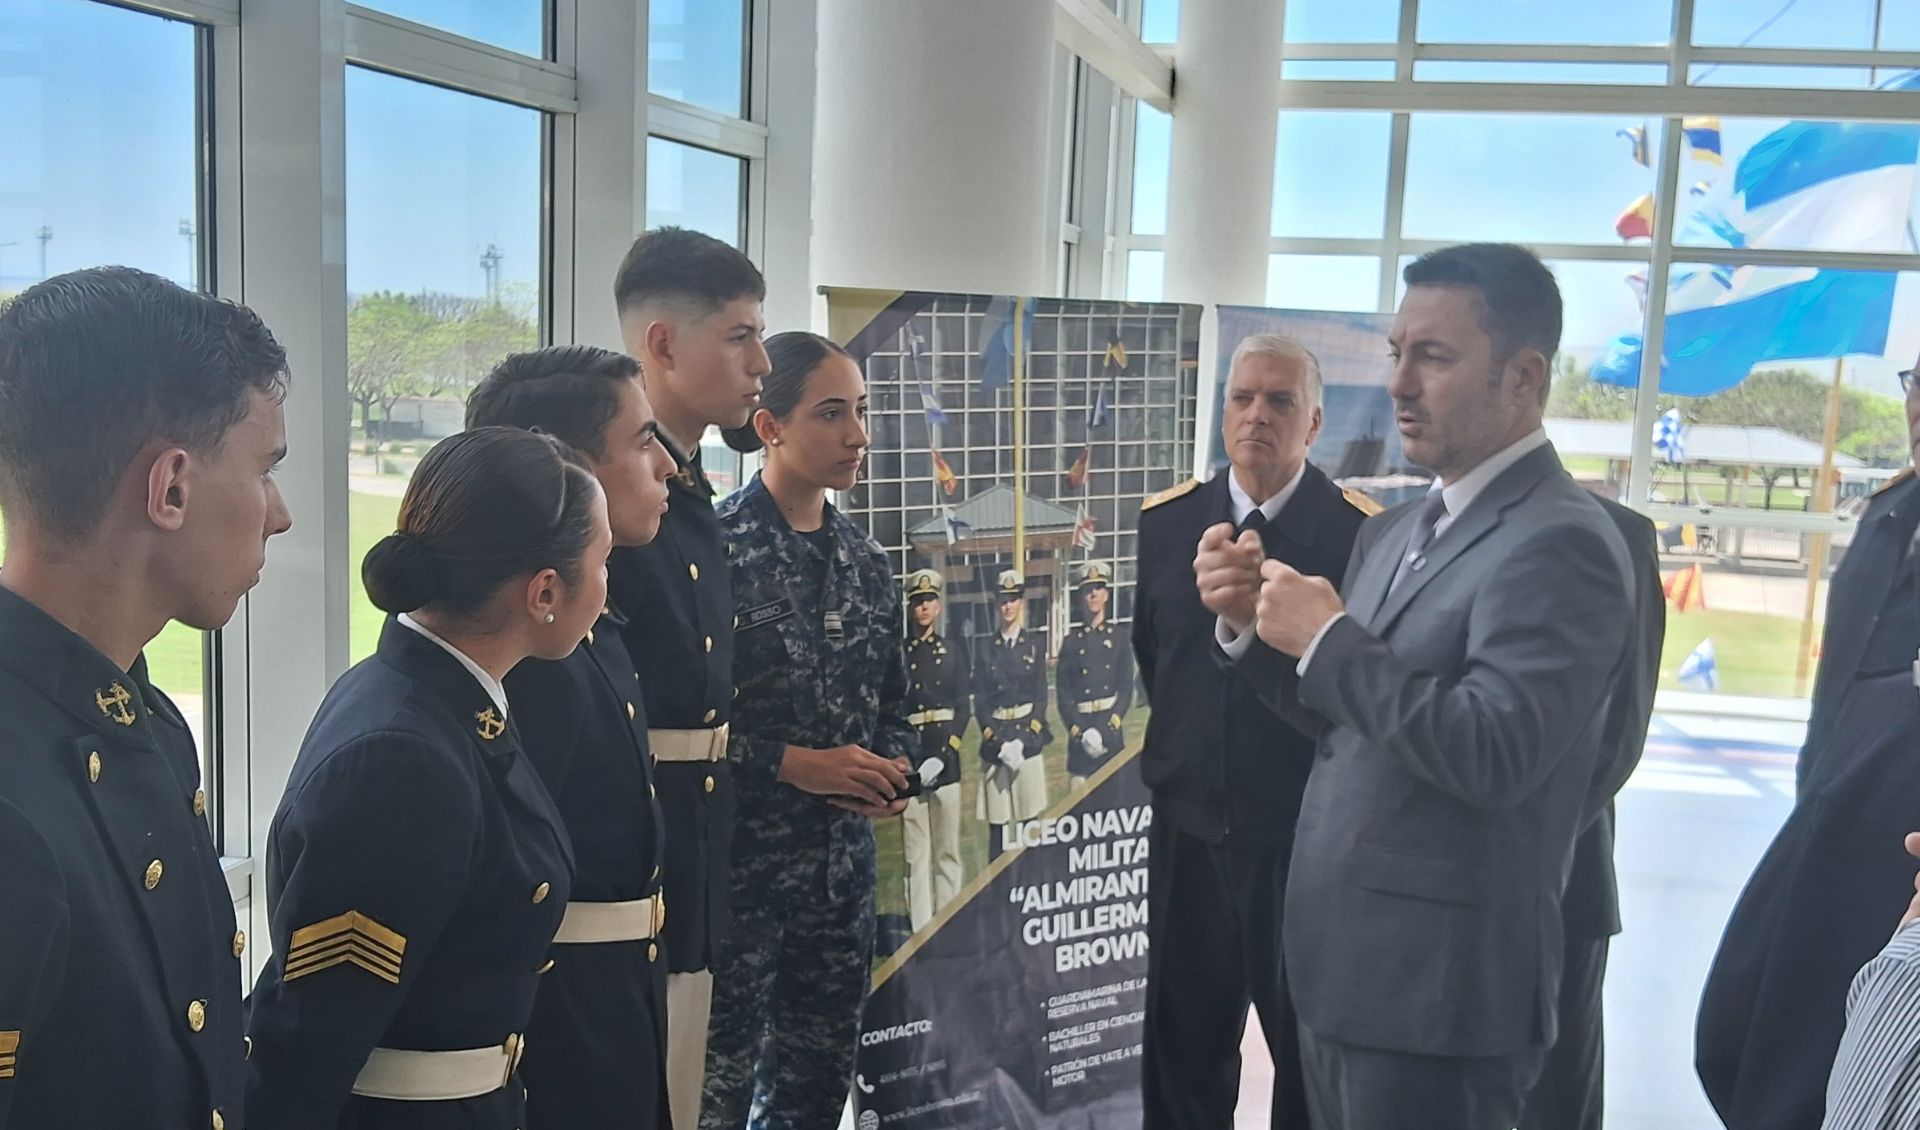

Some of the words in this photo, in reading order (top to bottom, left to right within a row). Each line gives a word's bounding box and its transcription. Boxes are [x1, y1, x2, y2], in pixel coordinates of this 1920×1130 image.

[1002, 815, 1079, 850] LICEO
[1048, 982, 1122, 1008] GUARDIAMARINA
[1123, 979, 1135, 991] DE
[1047, 1003, 1087, 1019] RESERVA
[1088, 995, 1118, 1010] NAVAL
[861, 1019, 933, 1046] CONTACTO:
[1048, 1022, 1095, 1042] BACHILLER
[1096, 1019, 1109, 1031] EN
[1049, 1032, 1101, 1053] NATURALES
[1051, 1058, 1087, 1076] PATRÓN
[1087, 1055, 1101, 1067] DE
[1101, 1048, 1122, 1063] YATE
[1052, 1070, 1086, 1088] MOTOR
